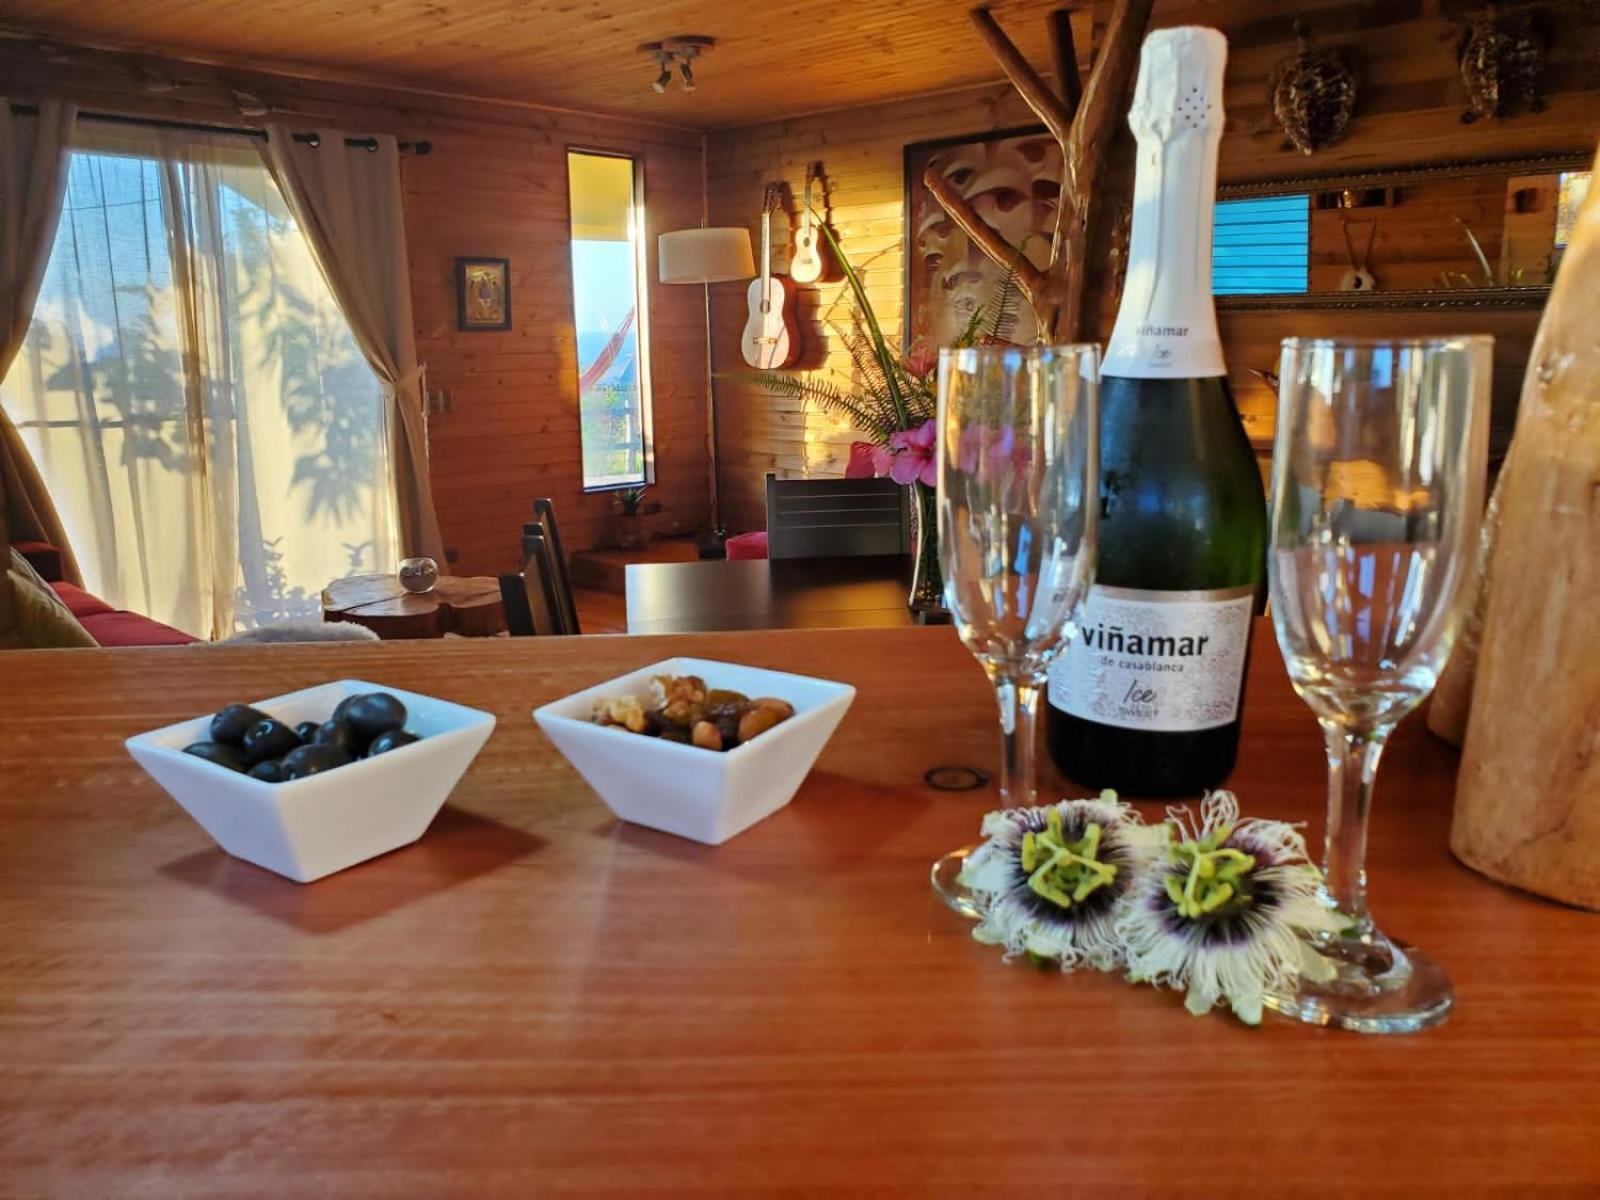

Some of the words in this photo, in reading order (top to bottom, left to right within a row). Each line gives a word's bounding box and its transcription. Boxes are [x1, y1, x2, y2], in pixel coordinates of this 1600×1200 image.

[1082, 624, 1209, 657] viñamar
[1100, 656, 1113, 668] de
[1119, 658, 1184, 672] casablanca
[1123, 679, 1157, 704] Ice
